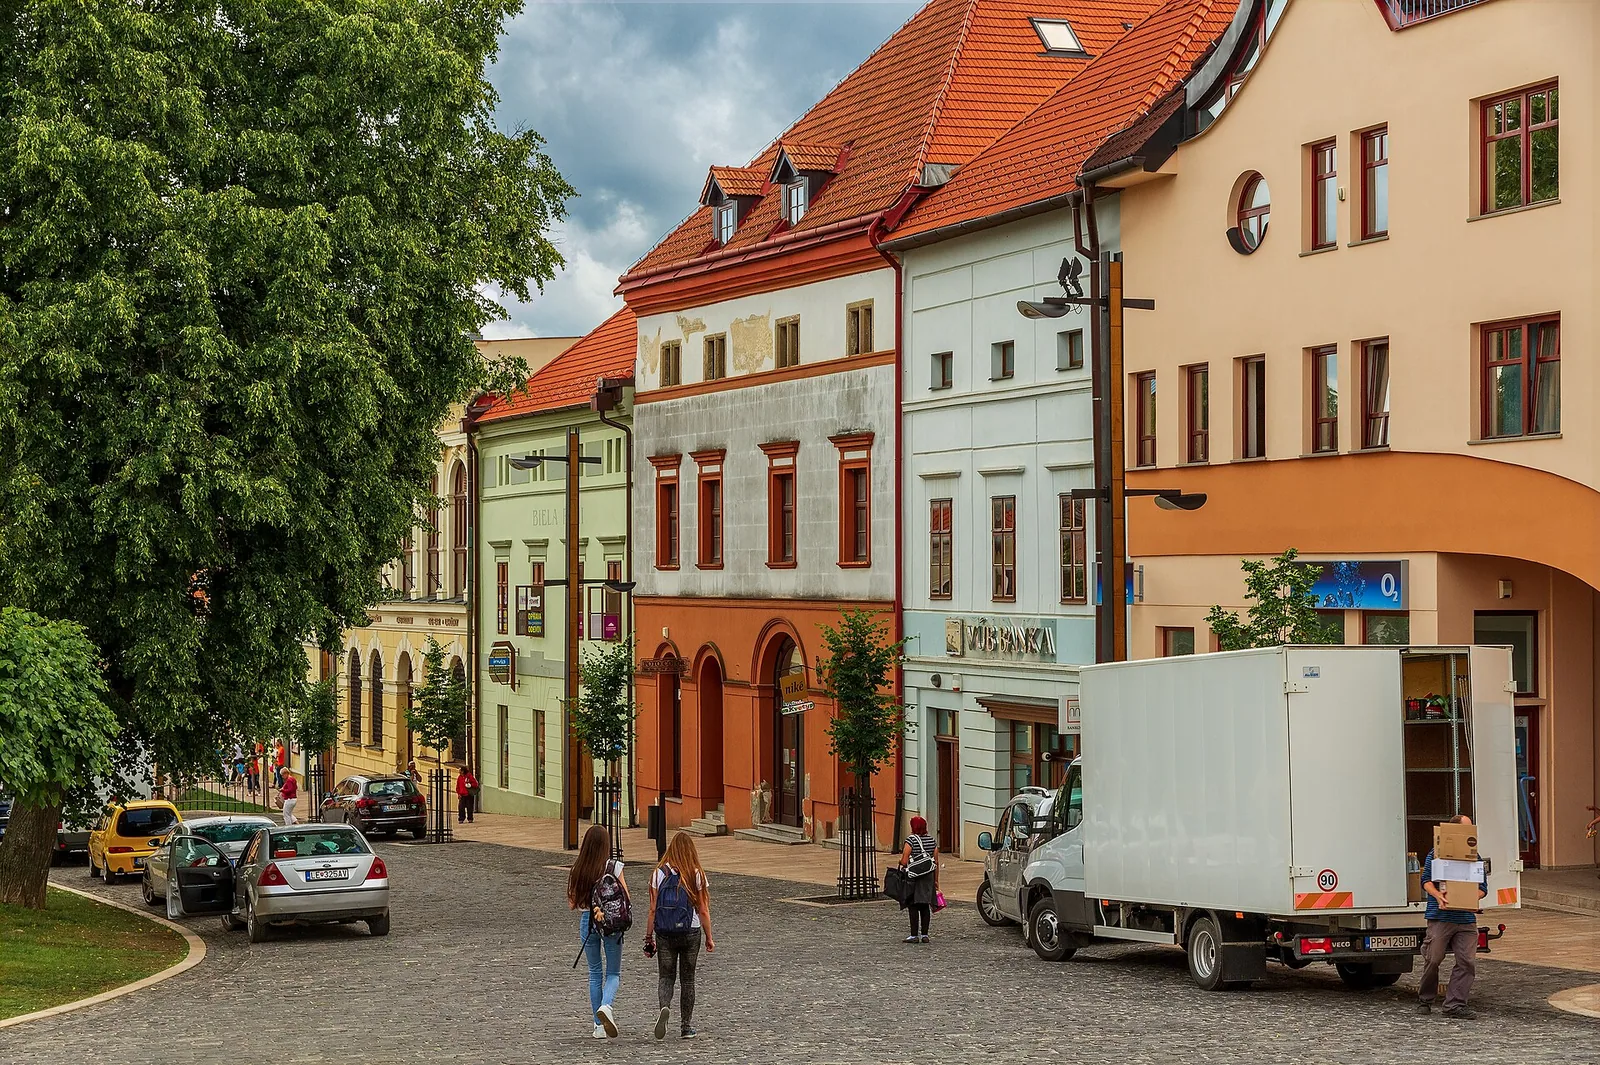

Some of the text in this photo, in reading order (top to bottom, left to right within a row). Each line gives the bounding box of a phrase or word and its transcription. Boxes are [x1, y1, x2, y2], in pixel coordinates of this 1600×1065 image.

[532, 509, 558, 526] BIELA
[1000, 625, 1057, 655] BANKA
[785, 680, 804, 694] niké
[1320, 874, 1335, 886] 90
